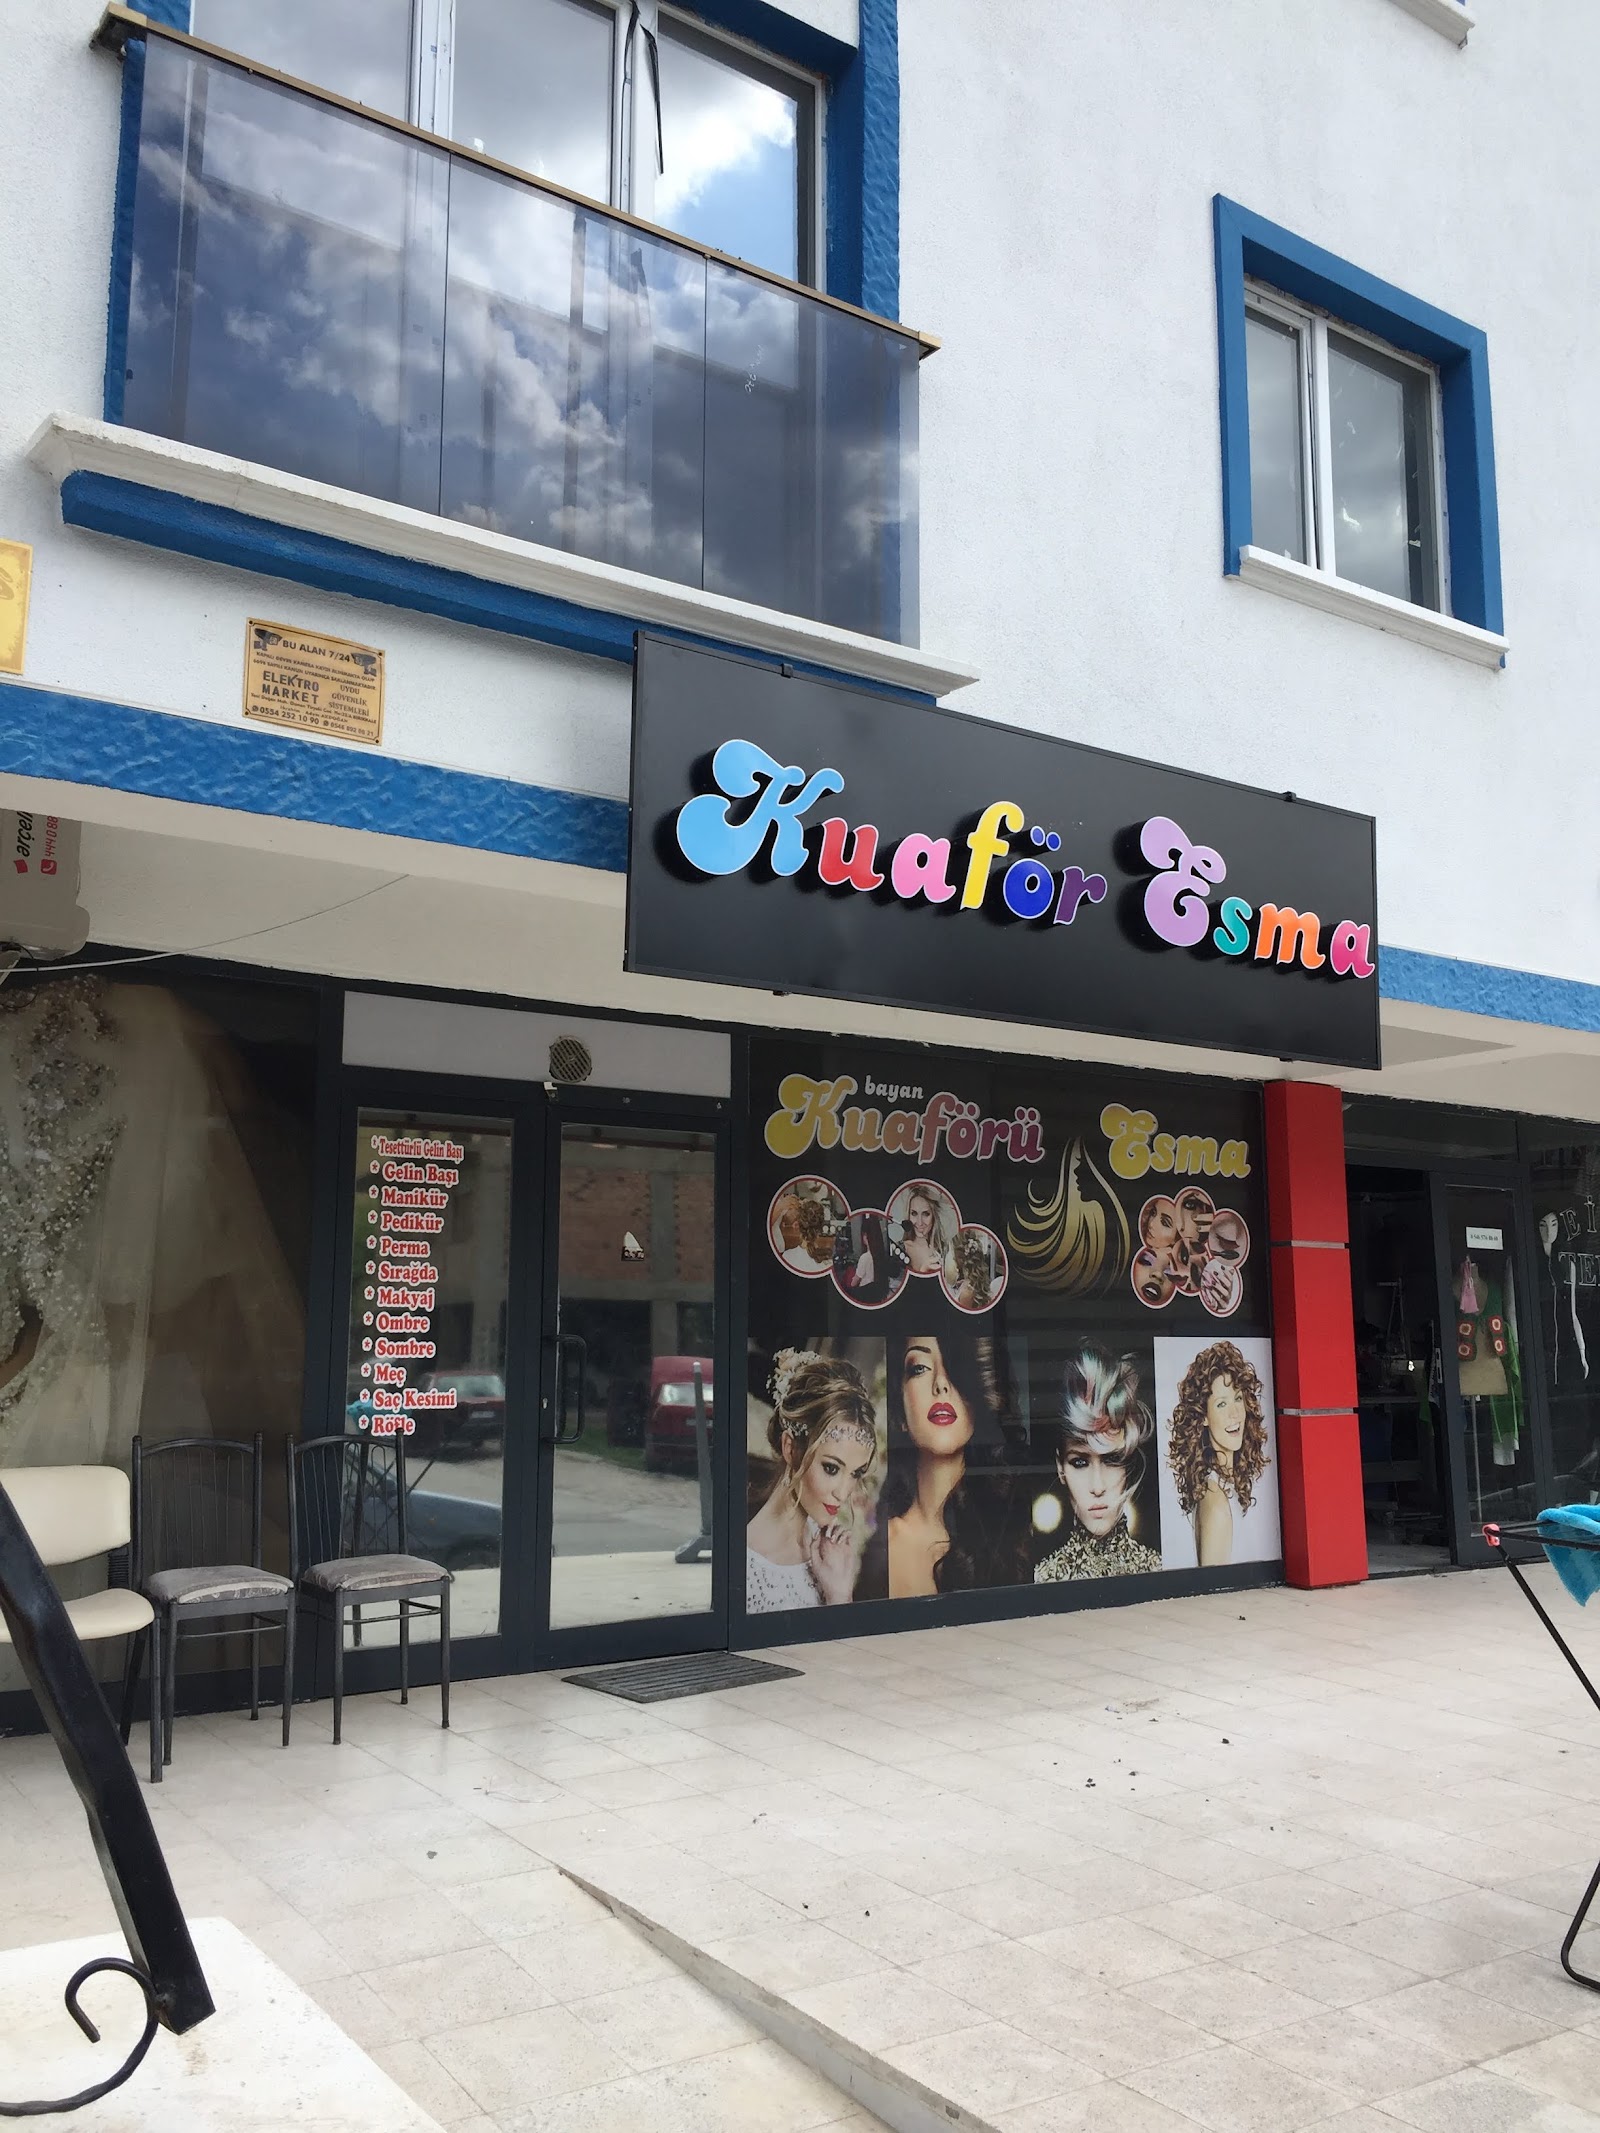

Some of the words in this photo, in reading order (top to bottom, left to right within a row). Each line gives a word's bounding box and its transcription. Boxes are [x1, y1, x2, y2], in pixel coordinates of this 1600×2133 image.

[283, 639, 296, 649] BU
[299, 643, 325, 656] ALAN
[329, 650, 349, 662] 7/24
[263, 670, 319, 692] ELEKTRO
[340, 684, 359, 694] UYDU
[262, 682, 318, 705] MARKET
[331, 691, 367, 706] GÜVENLİK
[259, 706, 279, 716] 0554
[281, 710, 295, 720] 252
[298, 714, 307, 723] 10
[309, 717, 319, 725] 90
[328, 700, 369, 716] SİSTEMLERİ
[676, 739, 1108, 926] Kuaför
[1140, 816, 1375, 979] Esma
[865, 1075, 924, 1103] bayan
[764, 1073, 1046, 1165] Kuaförü
[1099, 1102, 1252, 1180] Esma
[379, 1137, 422, 1157] Tesettürlü
[423, 1141, 445, 1158] Gelin
[446, 1142, 463, 1161] Başı
[383, 1162, 424, 1181] Gelin
[427, 1165, 458, 1186] Başı
[382, 1187, 448, 1207] Manikür
[381, 1212, 443, 1231] Pedikür
[380, 1237, 429, 1255] Perma
[379, 1262, 437, 1284] Sırağda
[1558, 1251, 1600, 1287] TE
[378, 1287, 434, 1310] Makyaj
[378, 1313, 429, 1331] Ombre
[376, 1339, 435, 1356] Sombre
[375, 1364, 405, 1386] Meç
[374, 1390, 402, 1411] Saç
[404, 1389, 456, 1408] Kesimi
[373, 1416, 415, 1434] Röfle
